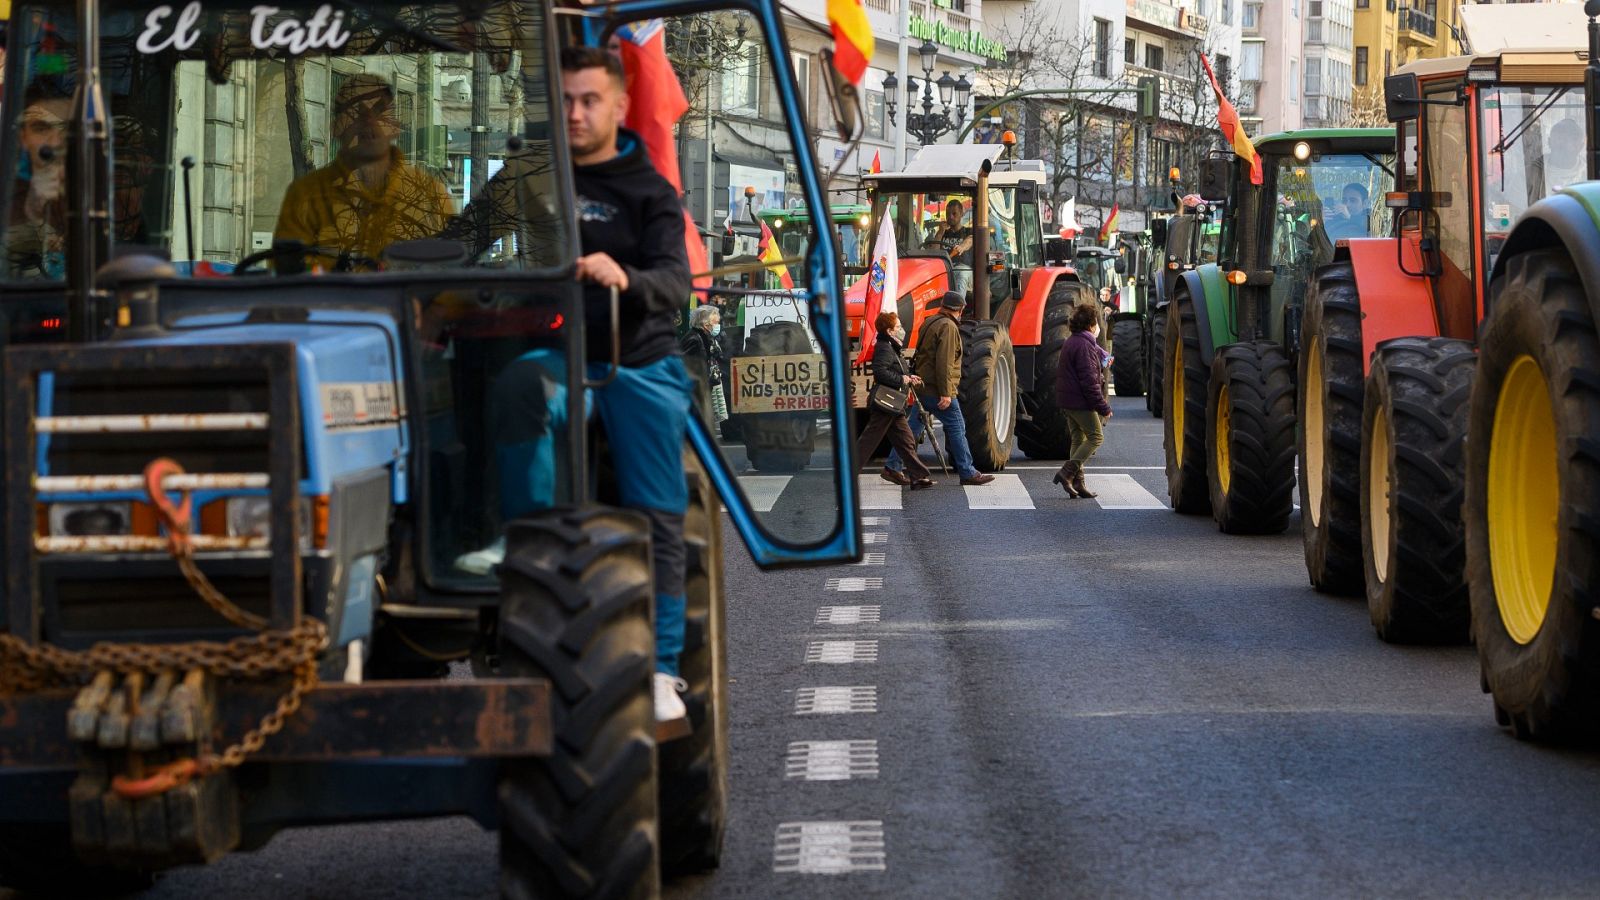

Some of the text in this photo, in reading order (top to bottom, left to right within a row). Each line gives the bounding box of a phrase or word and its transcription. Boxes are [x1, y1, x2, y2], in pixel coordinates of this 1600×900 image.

[136, 1, 350, 55] El Tati
[938, 20, 967, 52] Campos
[746, 290, 791, 308] LOBOS
[773, 362, 810, 382] LOS
[742, 384, 773, 397] NOS
